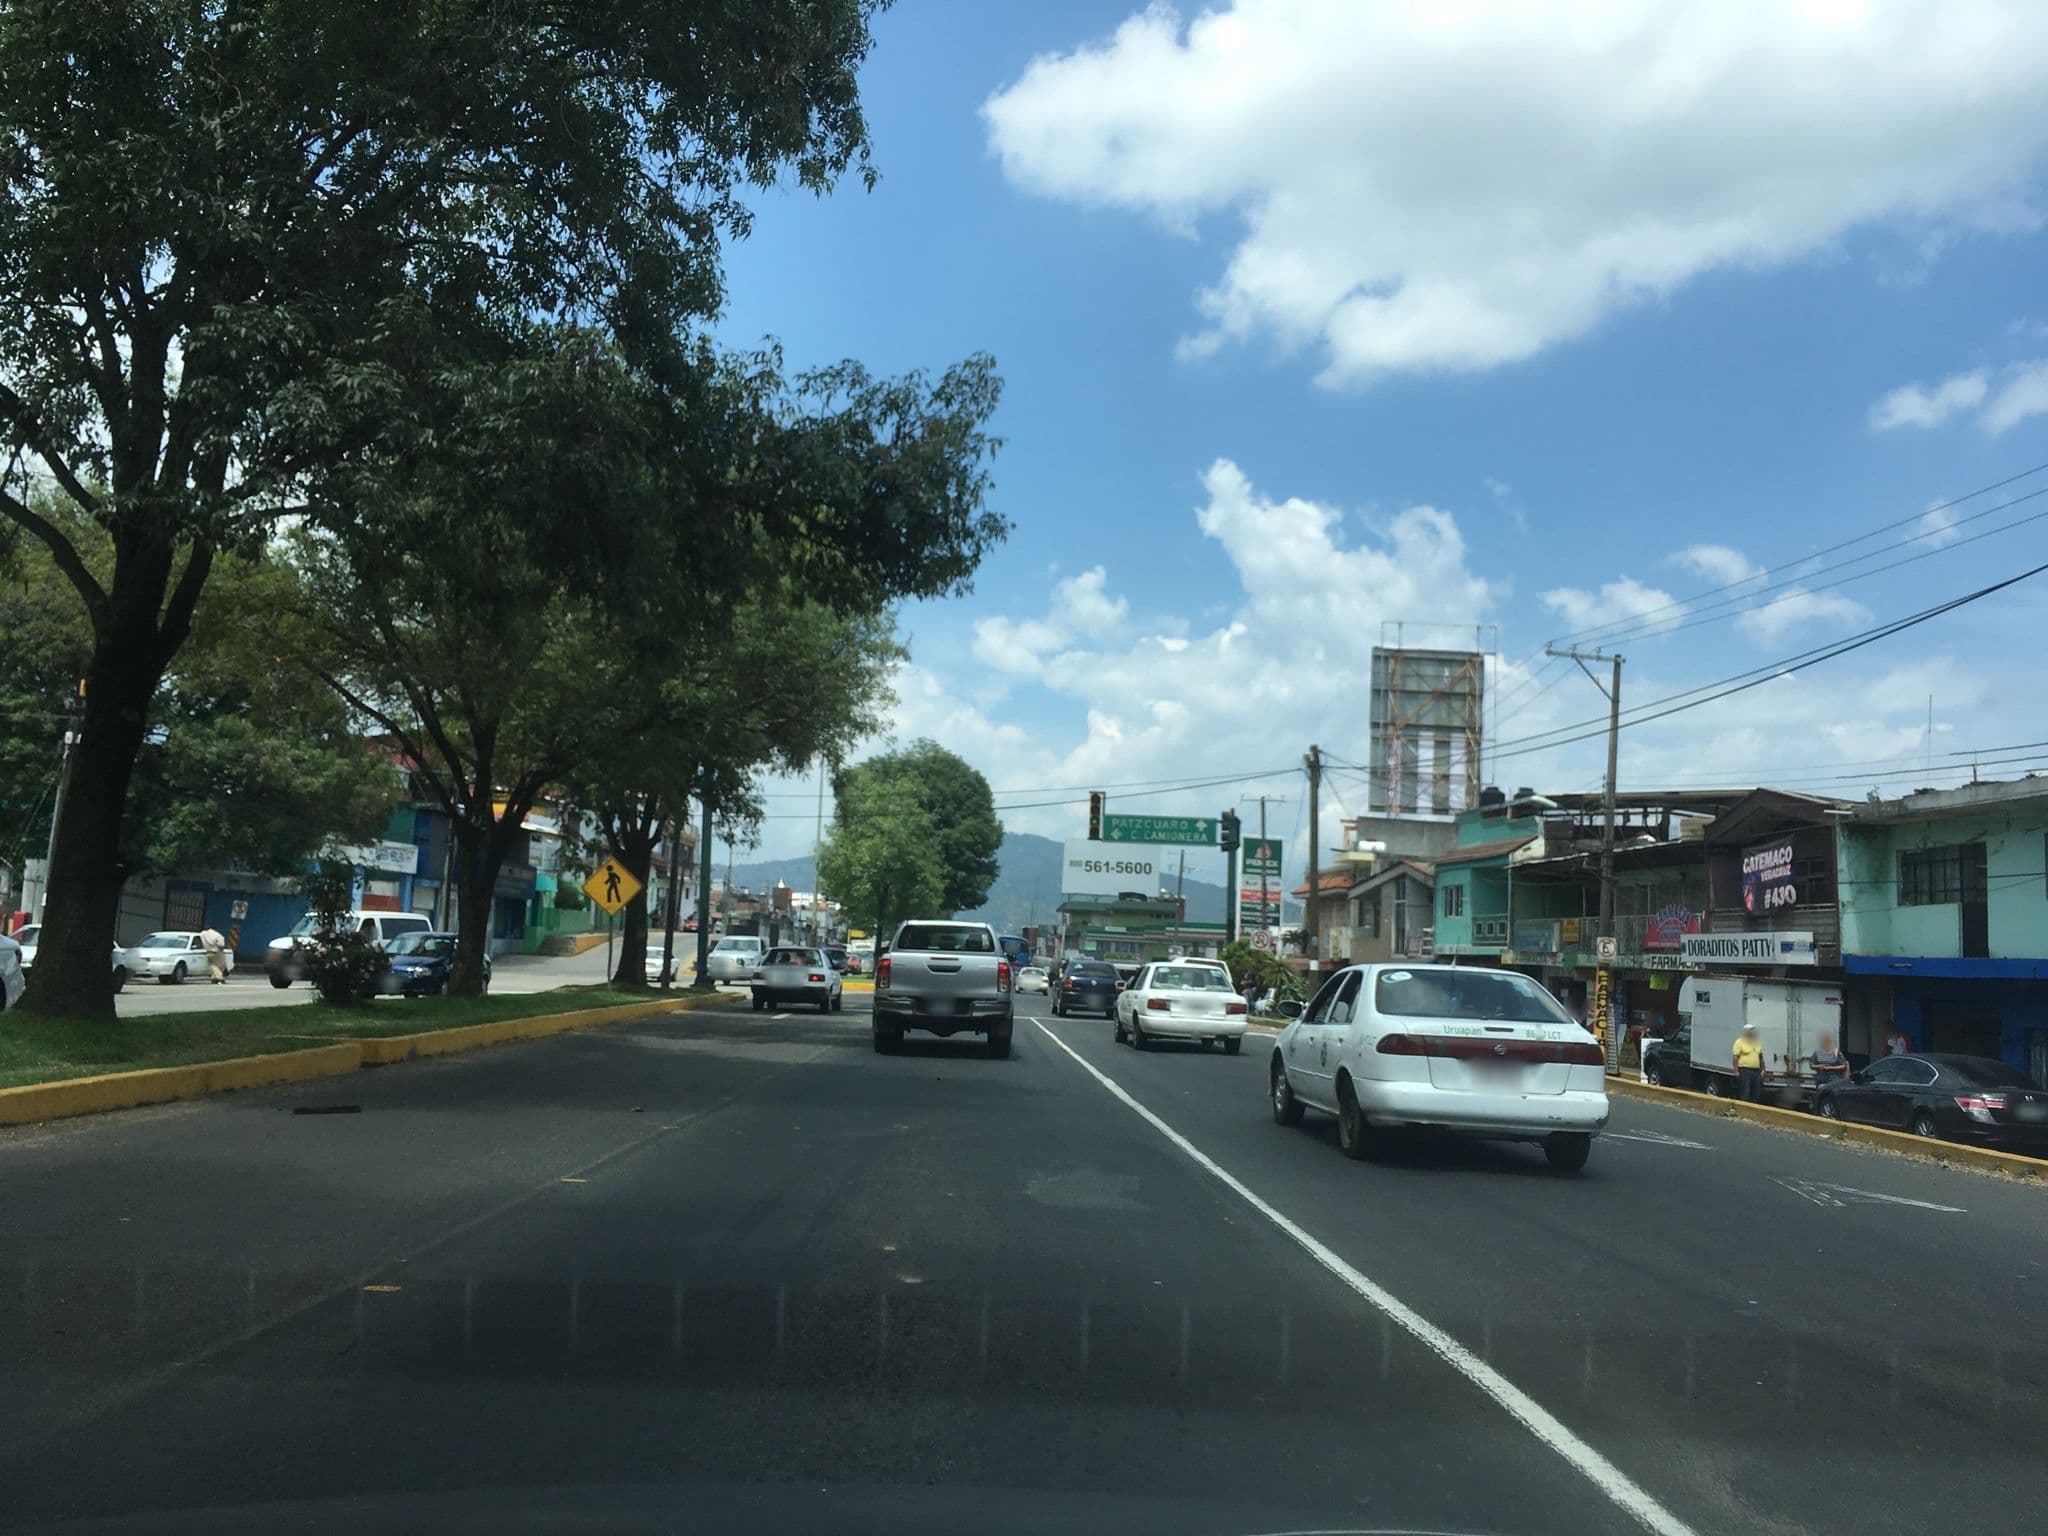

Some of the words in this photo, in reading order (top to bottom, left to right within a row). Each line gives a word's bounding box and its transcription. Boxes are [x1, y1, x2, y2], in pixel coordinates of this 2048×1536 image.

[1111, 817, 1188, 830] PATZCUARO
[1144, 831, 1208, 842] CAMIONERA
[1084, 860, 1152, 875] 561-5600
[1743, 845, 1793, 874] CATEMACO
[1760, 864, 1792, 882] VERACRUZ
[1765, 884, 1797, 909] #430
[1687, 939, 1739, 957] DORADITOS
[1443, 1025, 1481, 1036] Uruapan
